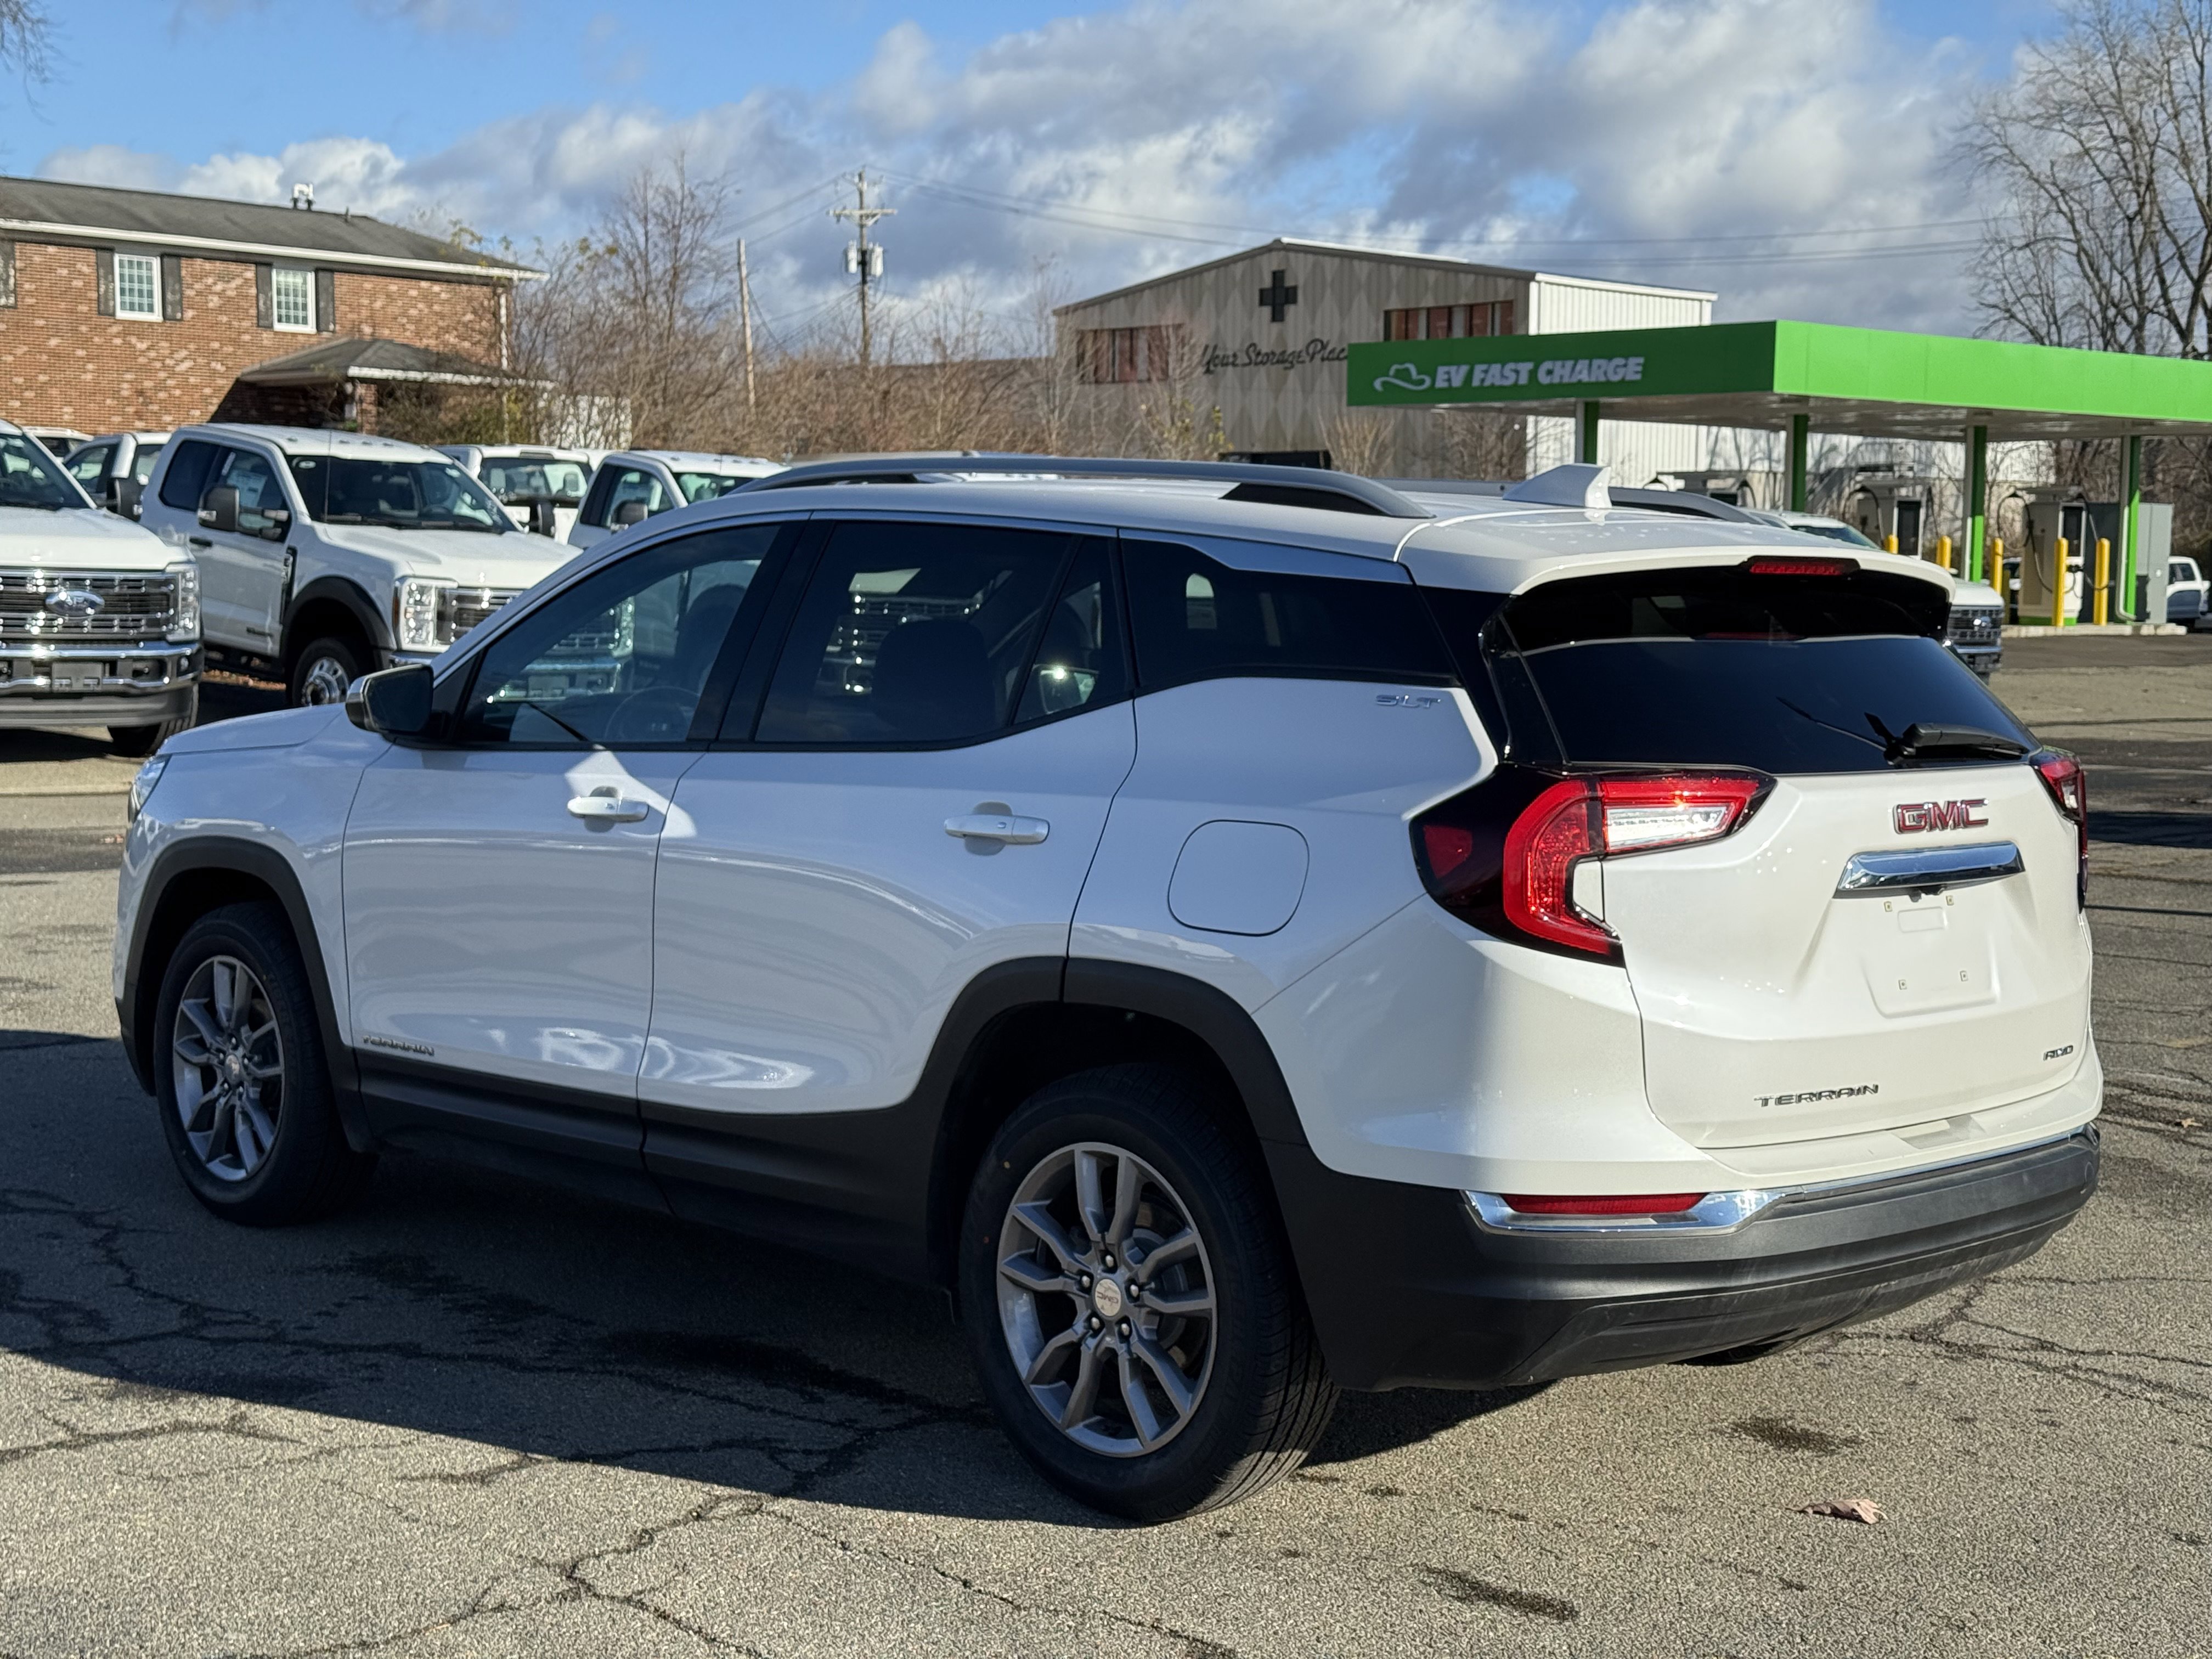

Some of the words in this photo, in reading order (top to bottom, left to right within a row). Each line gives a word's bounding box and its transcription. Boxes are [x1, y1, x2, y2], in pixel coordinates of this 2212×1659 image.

[1200, 343, 1239, 374] Your
[1240, 342, 1306, 370] Storage
[1305, 337, 1348, 363] Plac
[1435, 364, 1470, 388] EV
[1471, 362, 1534, 387] FAST
[1537, 357, 1645, 385] CHARGE
[1376, 694, 1441, 709] SLT
[1893, 798, 1989, 834] GMC
[1754, 1084, 1879, 1107] TERRAIN
[1097, 1290, 1119, 1304] GMC
